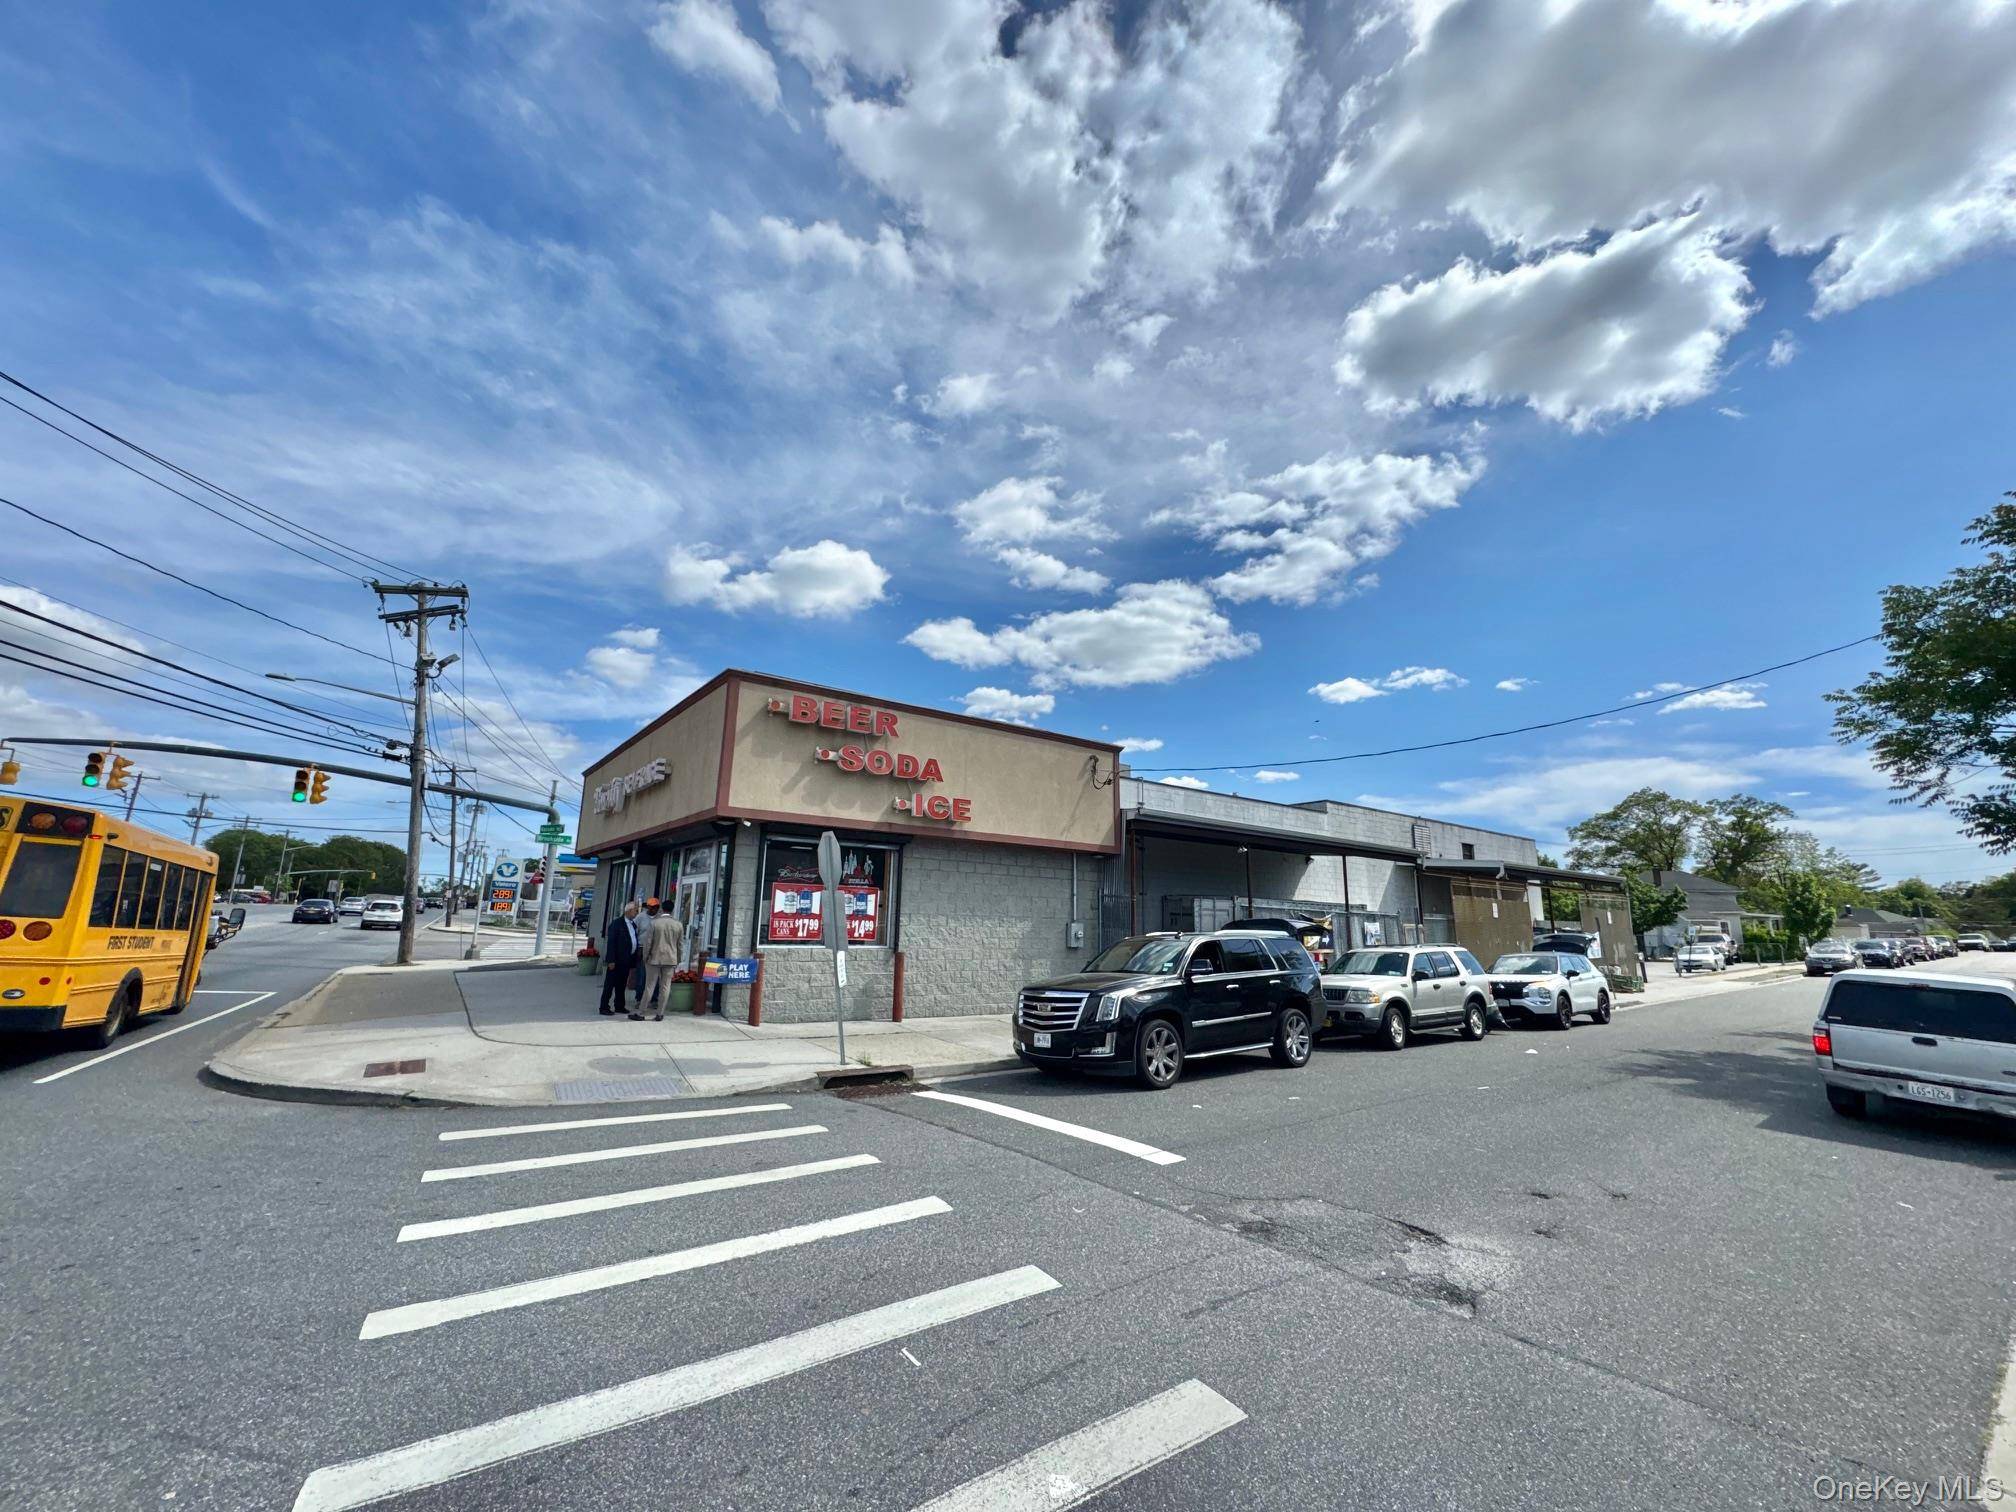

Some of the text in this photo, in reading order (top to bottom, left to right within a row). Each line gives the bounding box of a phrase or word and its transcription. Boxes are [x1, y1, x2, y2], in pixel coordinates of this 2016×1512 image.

[789, 694, 900, 738] BEER
[837, 744, 944, 783] SODA
[911, 792, 973, 823] ICE
[107, 936, 127, 950] FIRST
[127, 936, 155, 950] STUDENT
[728, 971, 750, 979] HERE
